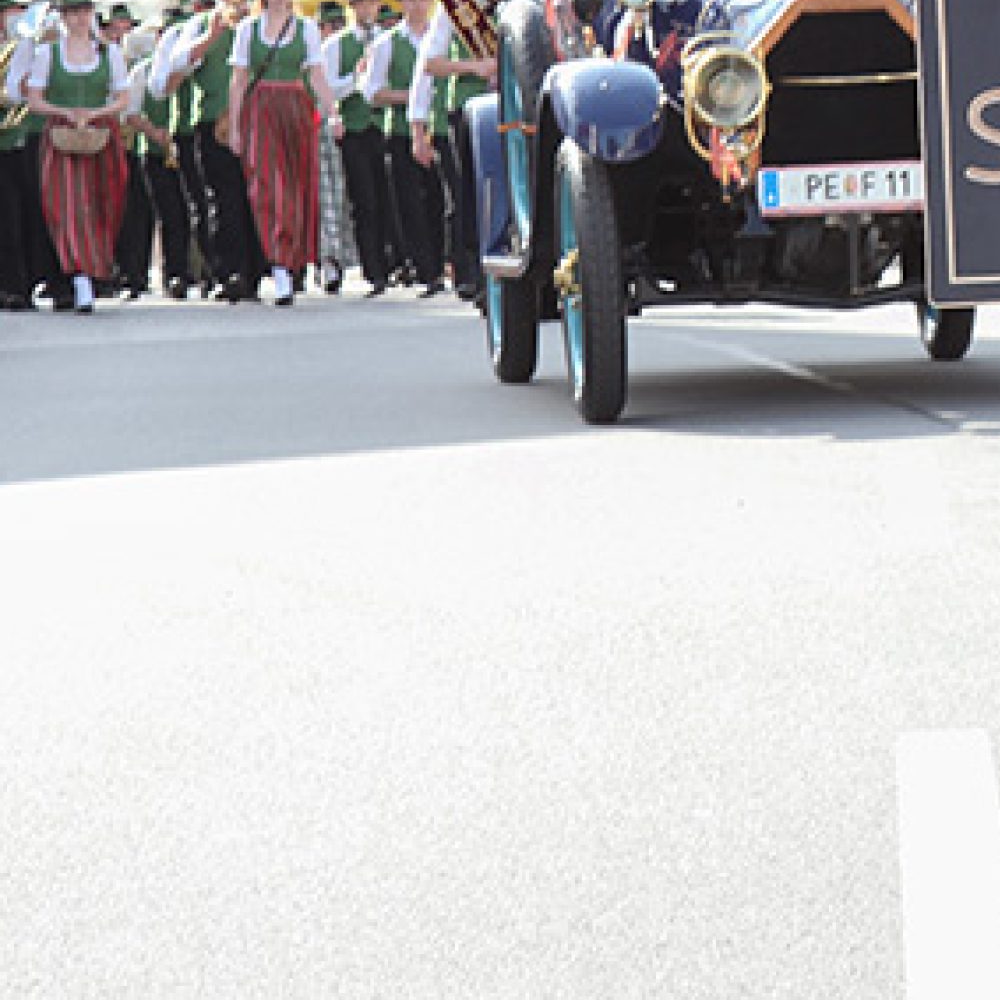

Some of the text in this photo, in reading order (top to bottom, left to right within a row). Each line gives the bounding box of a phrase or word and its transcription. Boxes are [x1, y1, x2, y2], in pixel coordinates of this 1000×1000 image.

[806, 169, 911, 200] PE F 11
